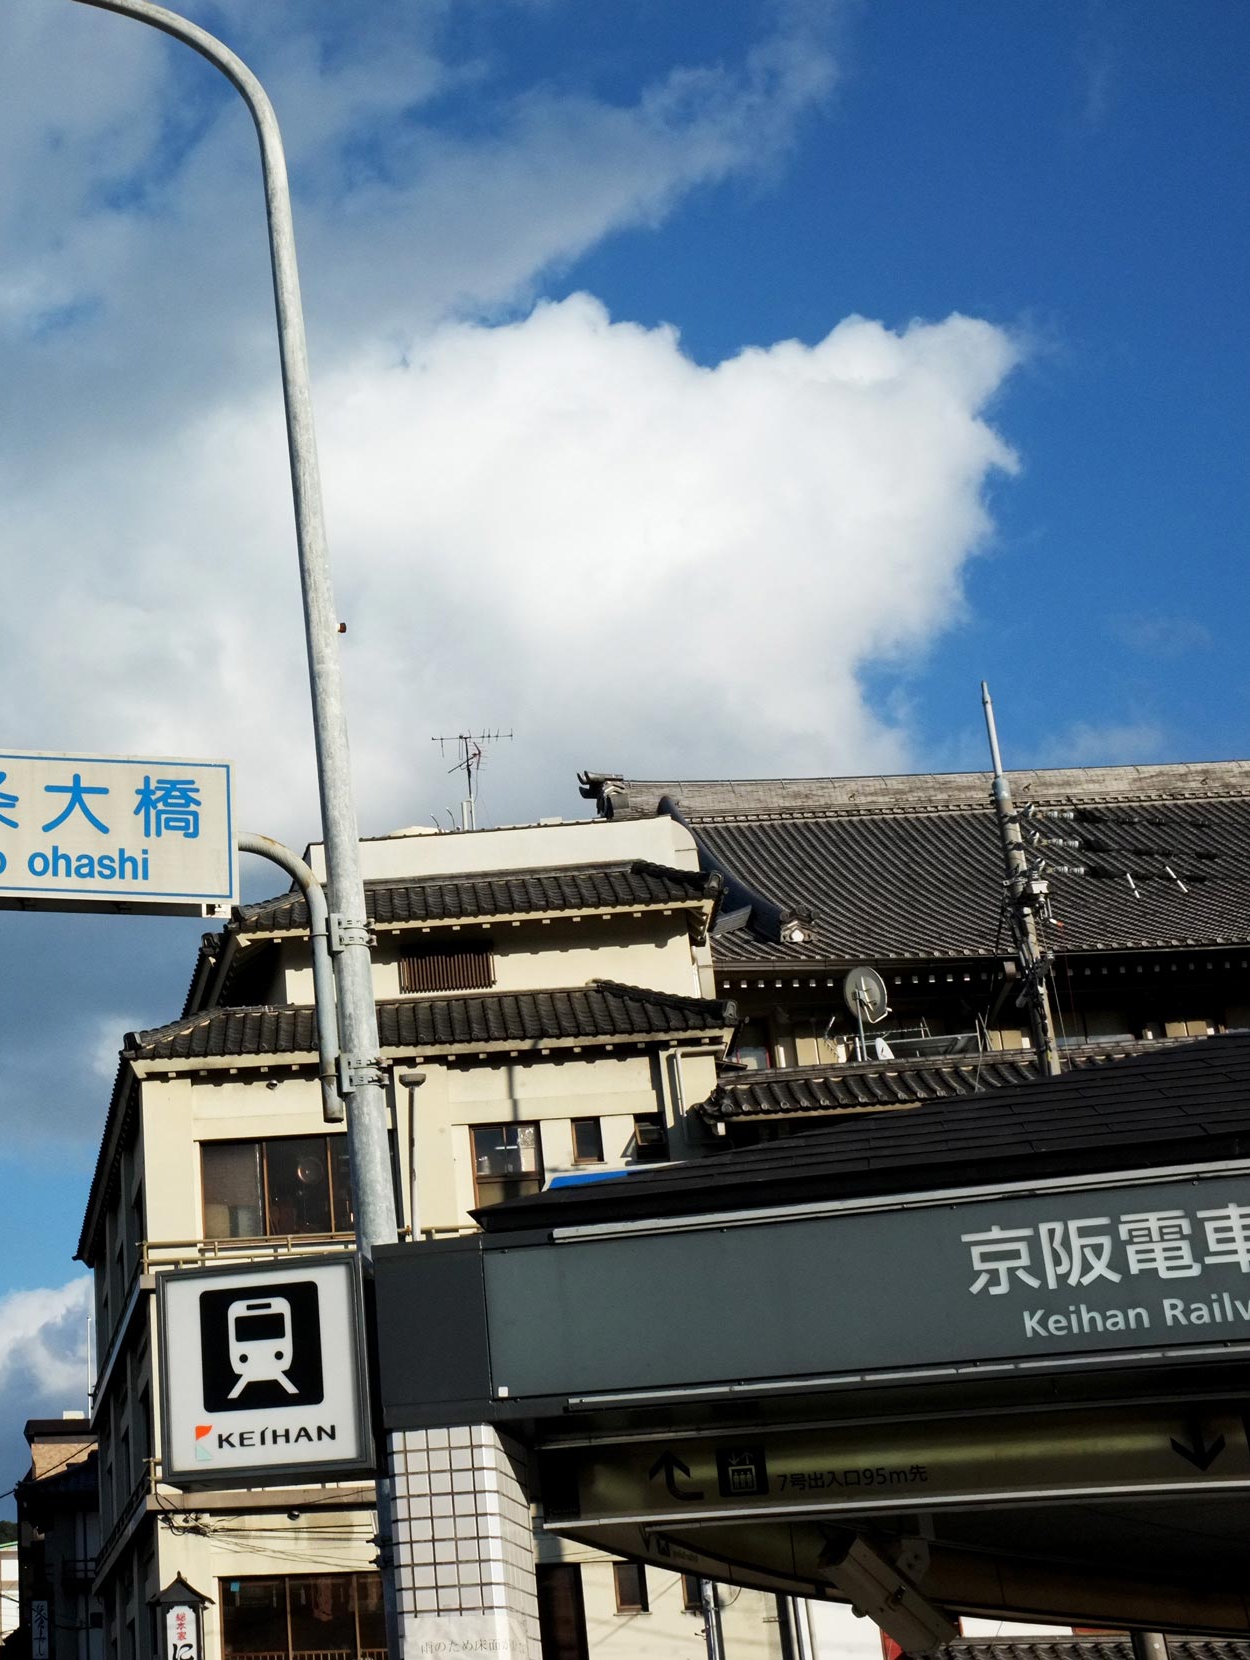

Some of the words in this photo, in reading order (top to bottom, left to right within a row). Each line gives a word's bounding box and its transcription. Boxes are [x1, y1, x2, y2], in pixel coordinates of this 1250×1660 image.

[27, 845, 150, 881] ohashi
[960, 1202, 1250, 1295] 京阪電車
[1022, 1303, 1150, 1338] Keihan
[217, 1424, 337, 1449] KEIHAN
[776, 1465, 928, 1492] 7号出入口95m先
